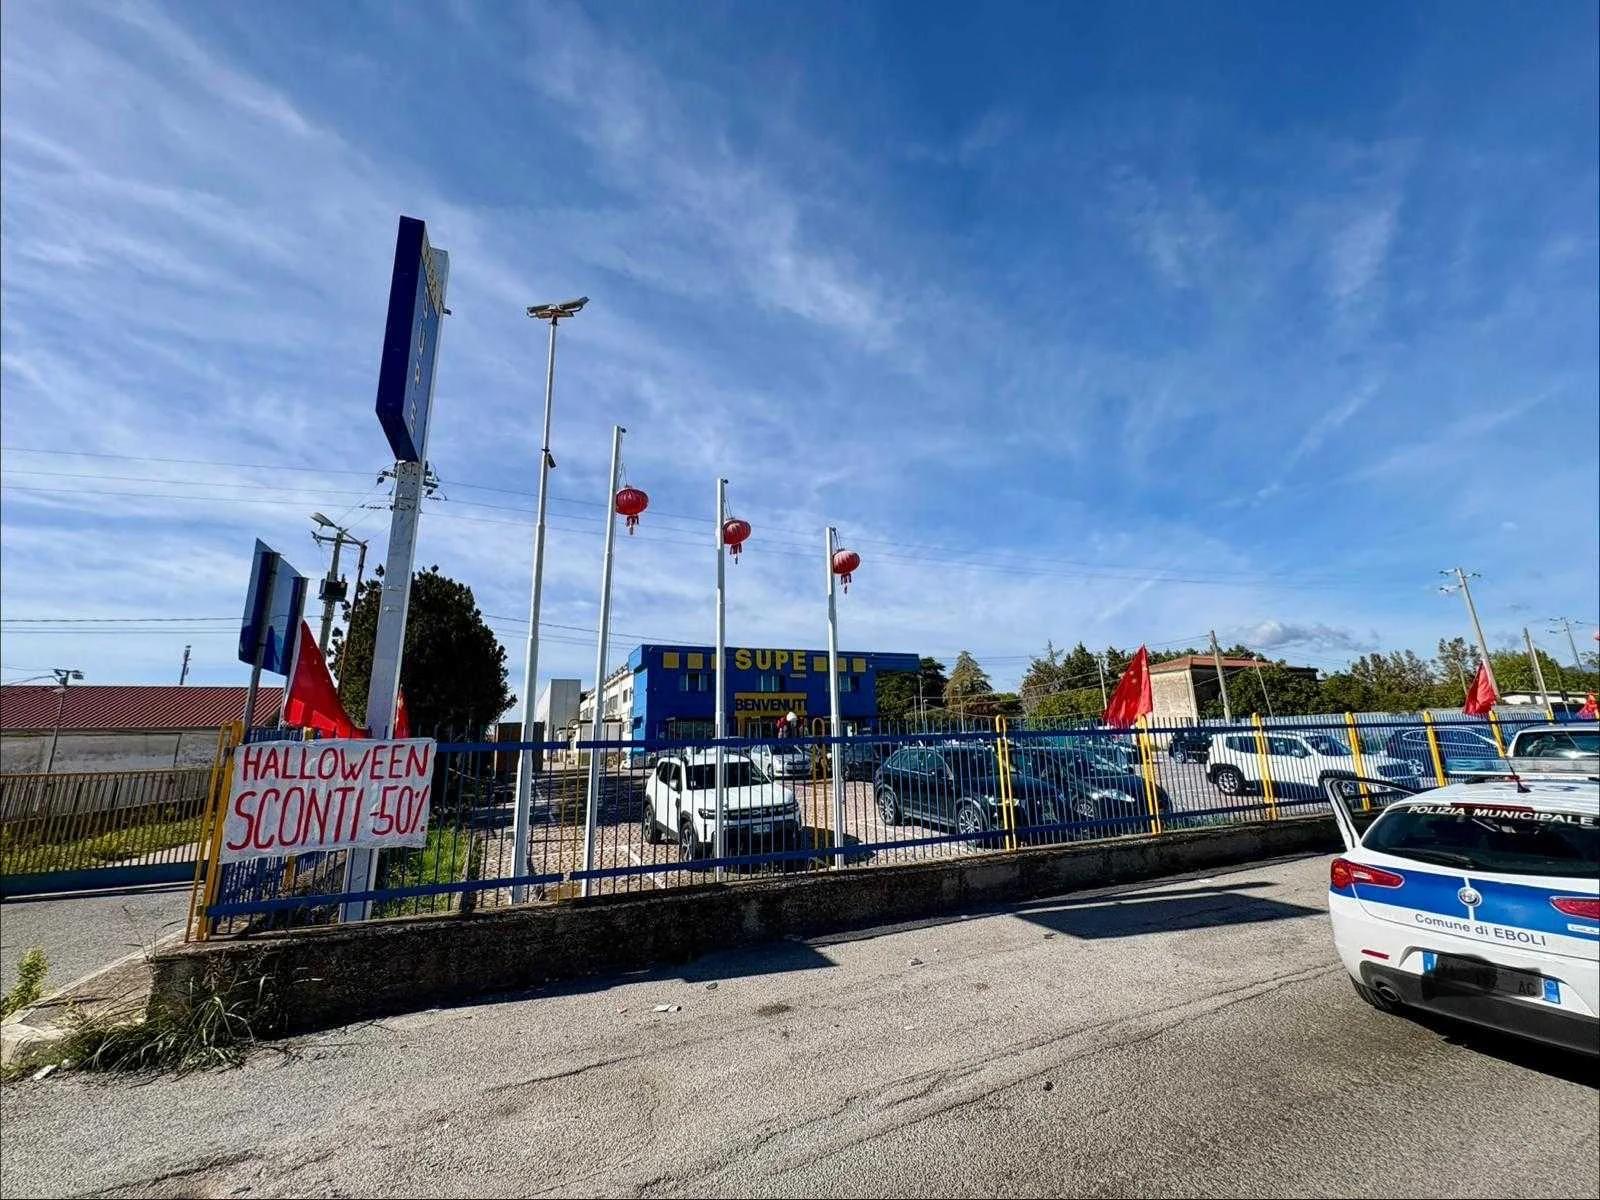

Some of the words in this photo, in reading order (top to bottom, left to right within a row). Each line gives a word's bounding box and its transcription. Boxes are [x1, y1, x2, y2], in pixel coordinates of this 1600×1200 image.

[735, 648, 807, 671] SUPE
[735, 698, 807, 712] BENVENUTI
[242, 743, 430, 782] HALLOWEEN
[226, 786, 365, 851] SCONTI
[370, 784, 430, 836] -50%
[1407, 806, 1466, 816] POLIZIA
[1472, 808, 1595, 827] MUNICIPALE
[1415, 913, 1471, 932] Comune
[1475, 925, 1489, 936] di
[1494, 927, 1547, 947] EBOLI
